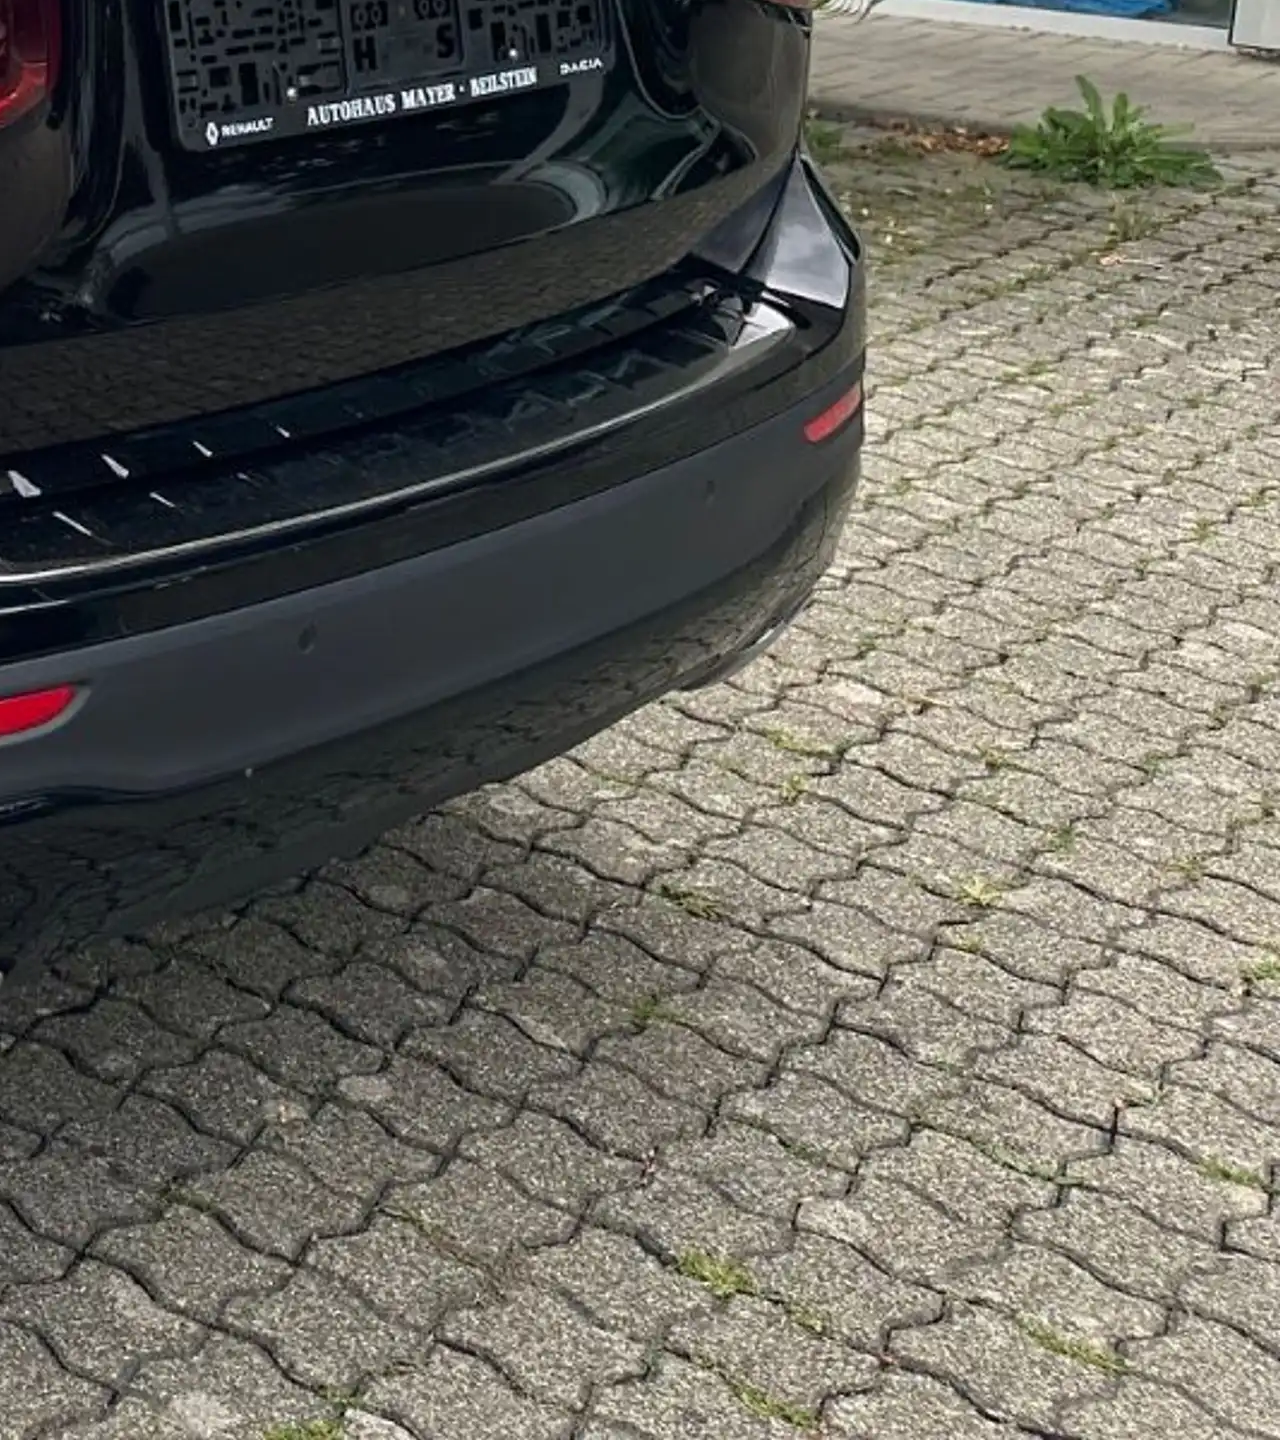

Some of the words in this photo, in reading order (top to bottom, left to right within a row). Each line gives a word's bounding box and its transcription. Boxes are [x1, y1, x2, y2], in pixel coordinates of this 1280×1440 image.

[559, 57, 603, 75] DACIA
[306, 93, 396, 126] AUTOHAUS
[401, 82, 456, 110] MAYER
[469, 66, 537, 97] BEILSTEIN
[221, 116, 274, 137] RENAULT
